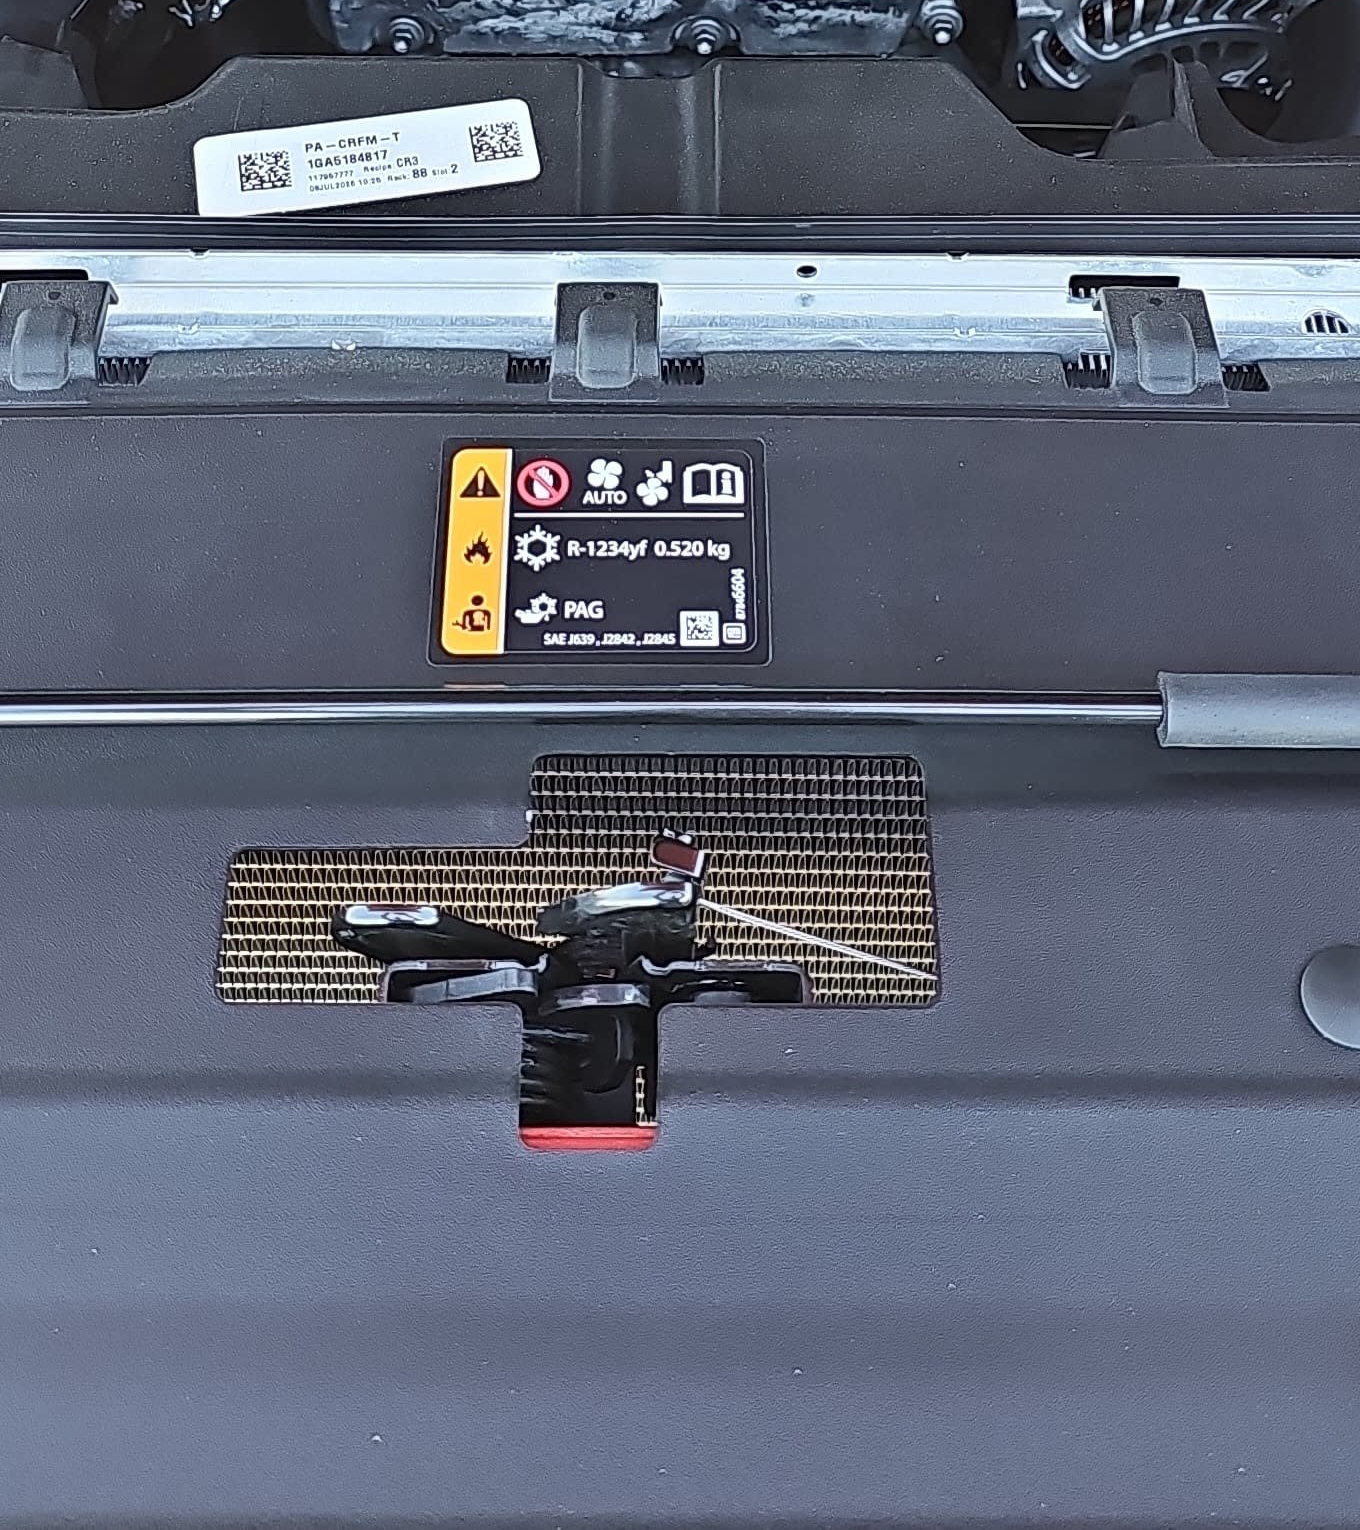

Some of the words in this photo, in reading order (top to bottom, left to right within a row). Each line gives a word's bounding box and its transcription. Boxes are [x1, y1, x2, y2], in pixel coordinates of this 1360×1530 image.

[307, 149, 388, 170] 1GA5184817
[396, 156, 419, 168] CR3
[412, 167, 428, 179] 88
[450, 163, 459, 174] 2
[582, 490, 628, 505] AUTO
[567, 539, 648, 561] R-1234yf
[653, 540, 705, 558] 0.520
[706, 539, 731, 561] kg
[563, 600, 605, 620] PAG
[543, 632, 567, 646] SAE
[641, 631, 676, 646] J2845
